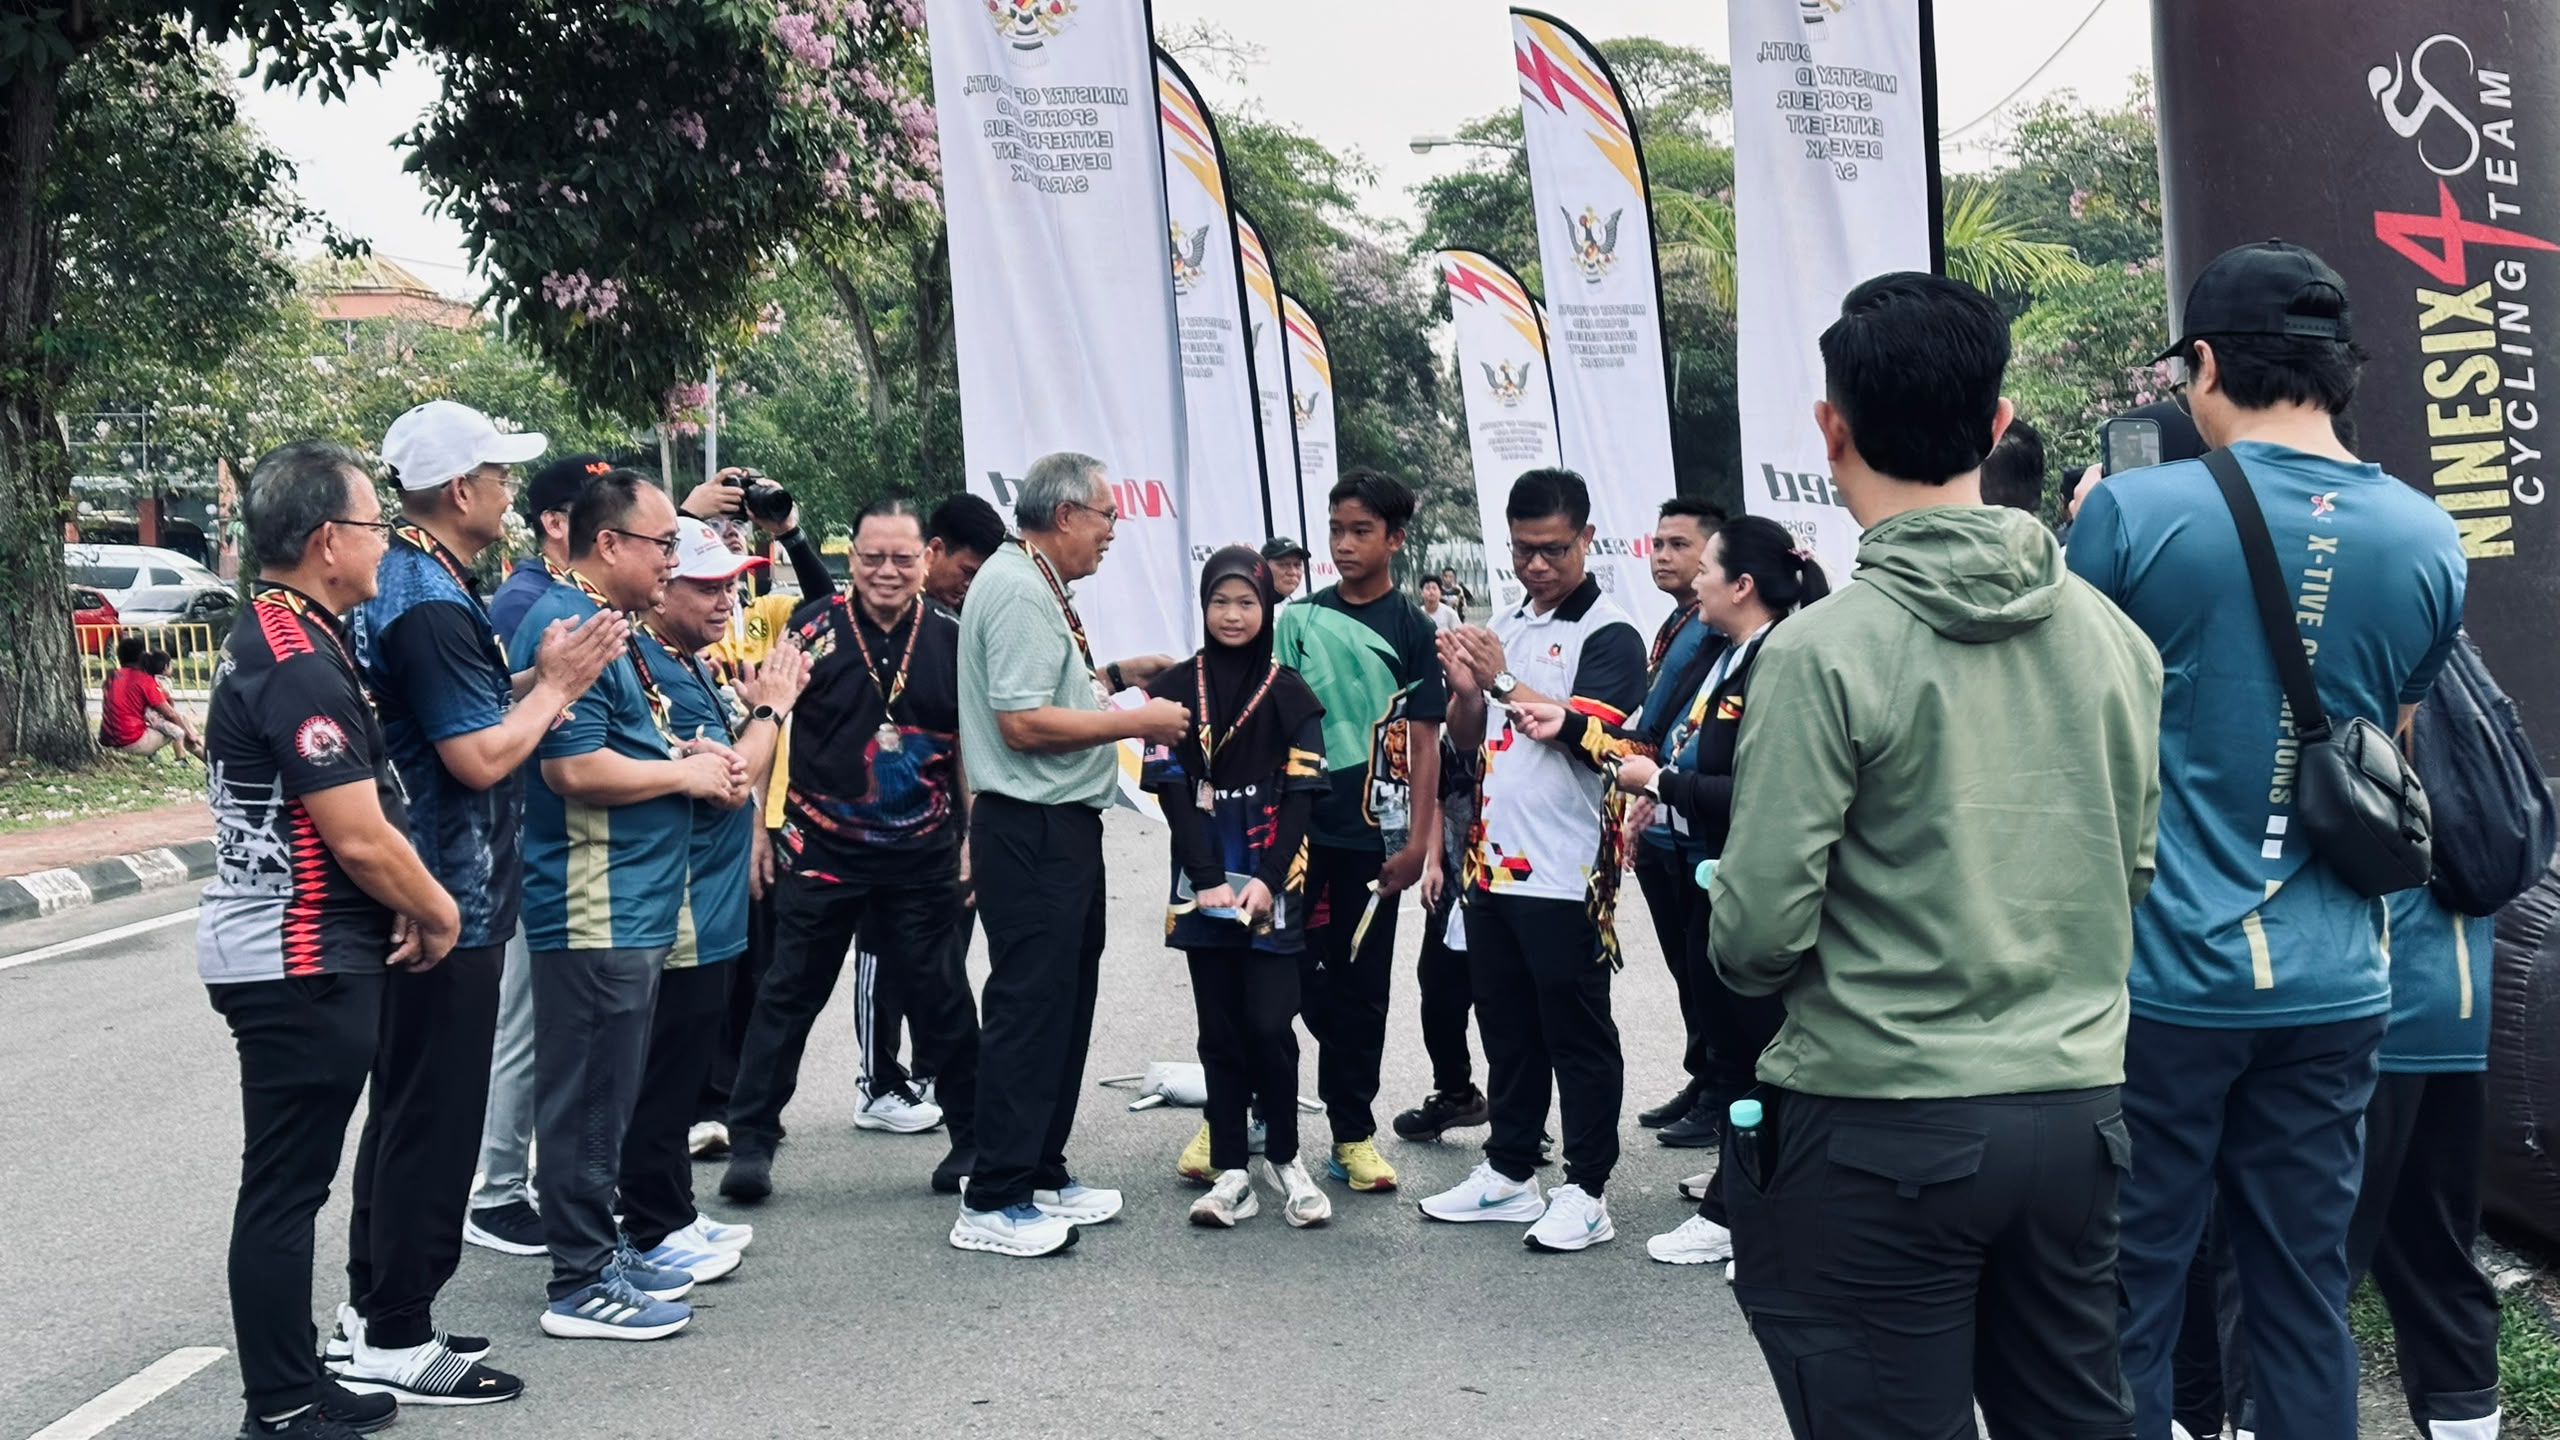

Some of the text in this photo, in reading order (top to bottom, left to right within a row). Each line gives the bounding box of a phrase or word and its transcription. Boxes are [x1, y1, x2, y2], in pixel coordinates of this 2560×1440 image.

[2478, 69, 2522, 220] TEAM
[2494, 259, 2546, 506] CYCLING
[2296, 533, 2339, 628] X-TIVE
